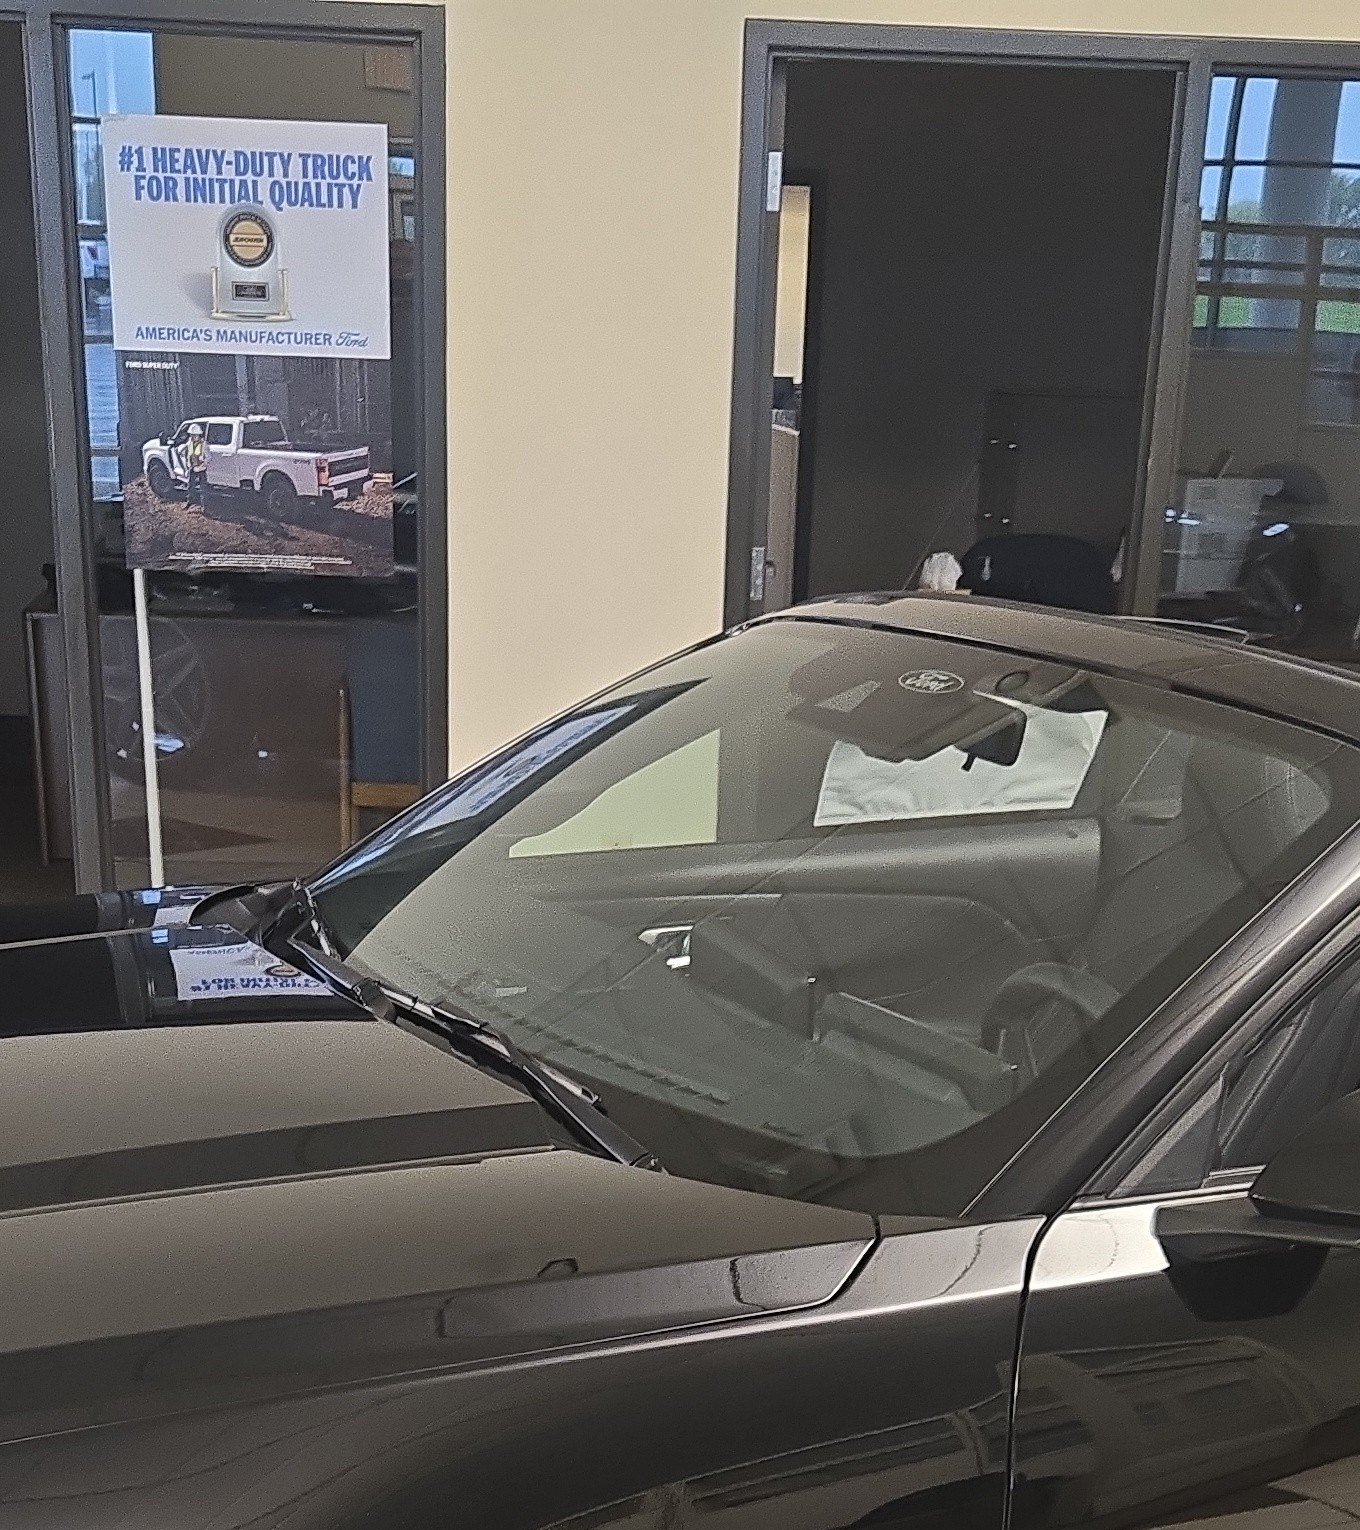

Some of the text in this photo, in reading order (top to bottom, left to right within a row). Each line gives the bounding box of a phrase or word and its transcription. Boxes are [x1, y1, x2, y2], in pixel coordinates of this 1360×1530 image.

[119, 145, 373, 182] #1 HEAVY-DUTY TRUCK
[134, 175, 362, 212] FOR INITIAL QUALITY
[135, 326, 370, 348] AMERICA'S MANUFACTURER Ford
